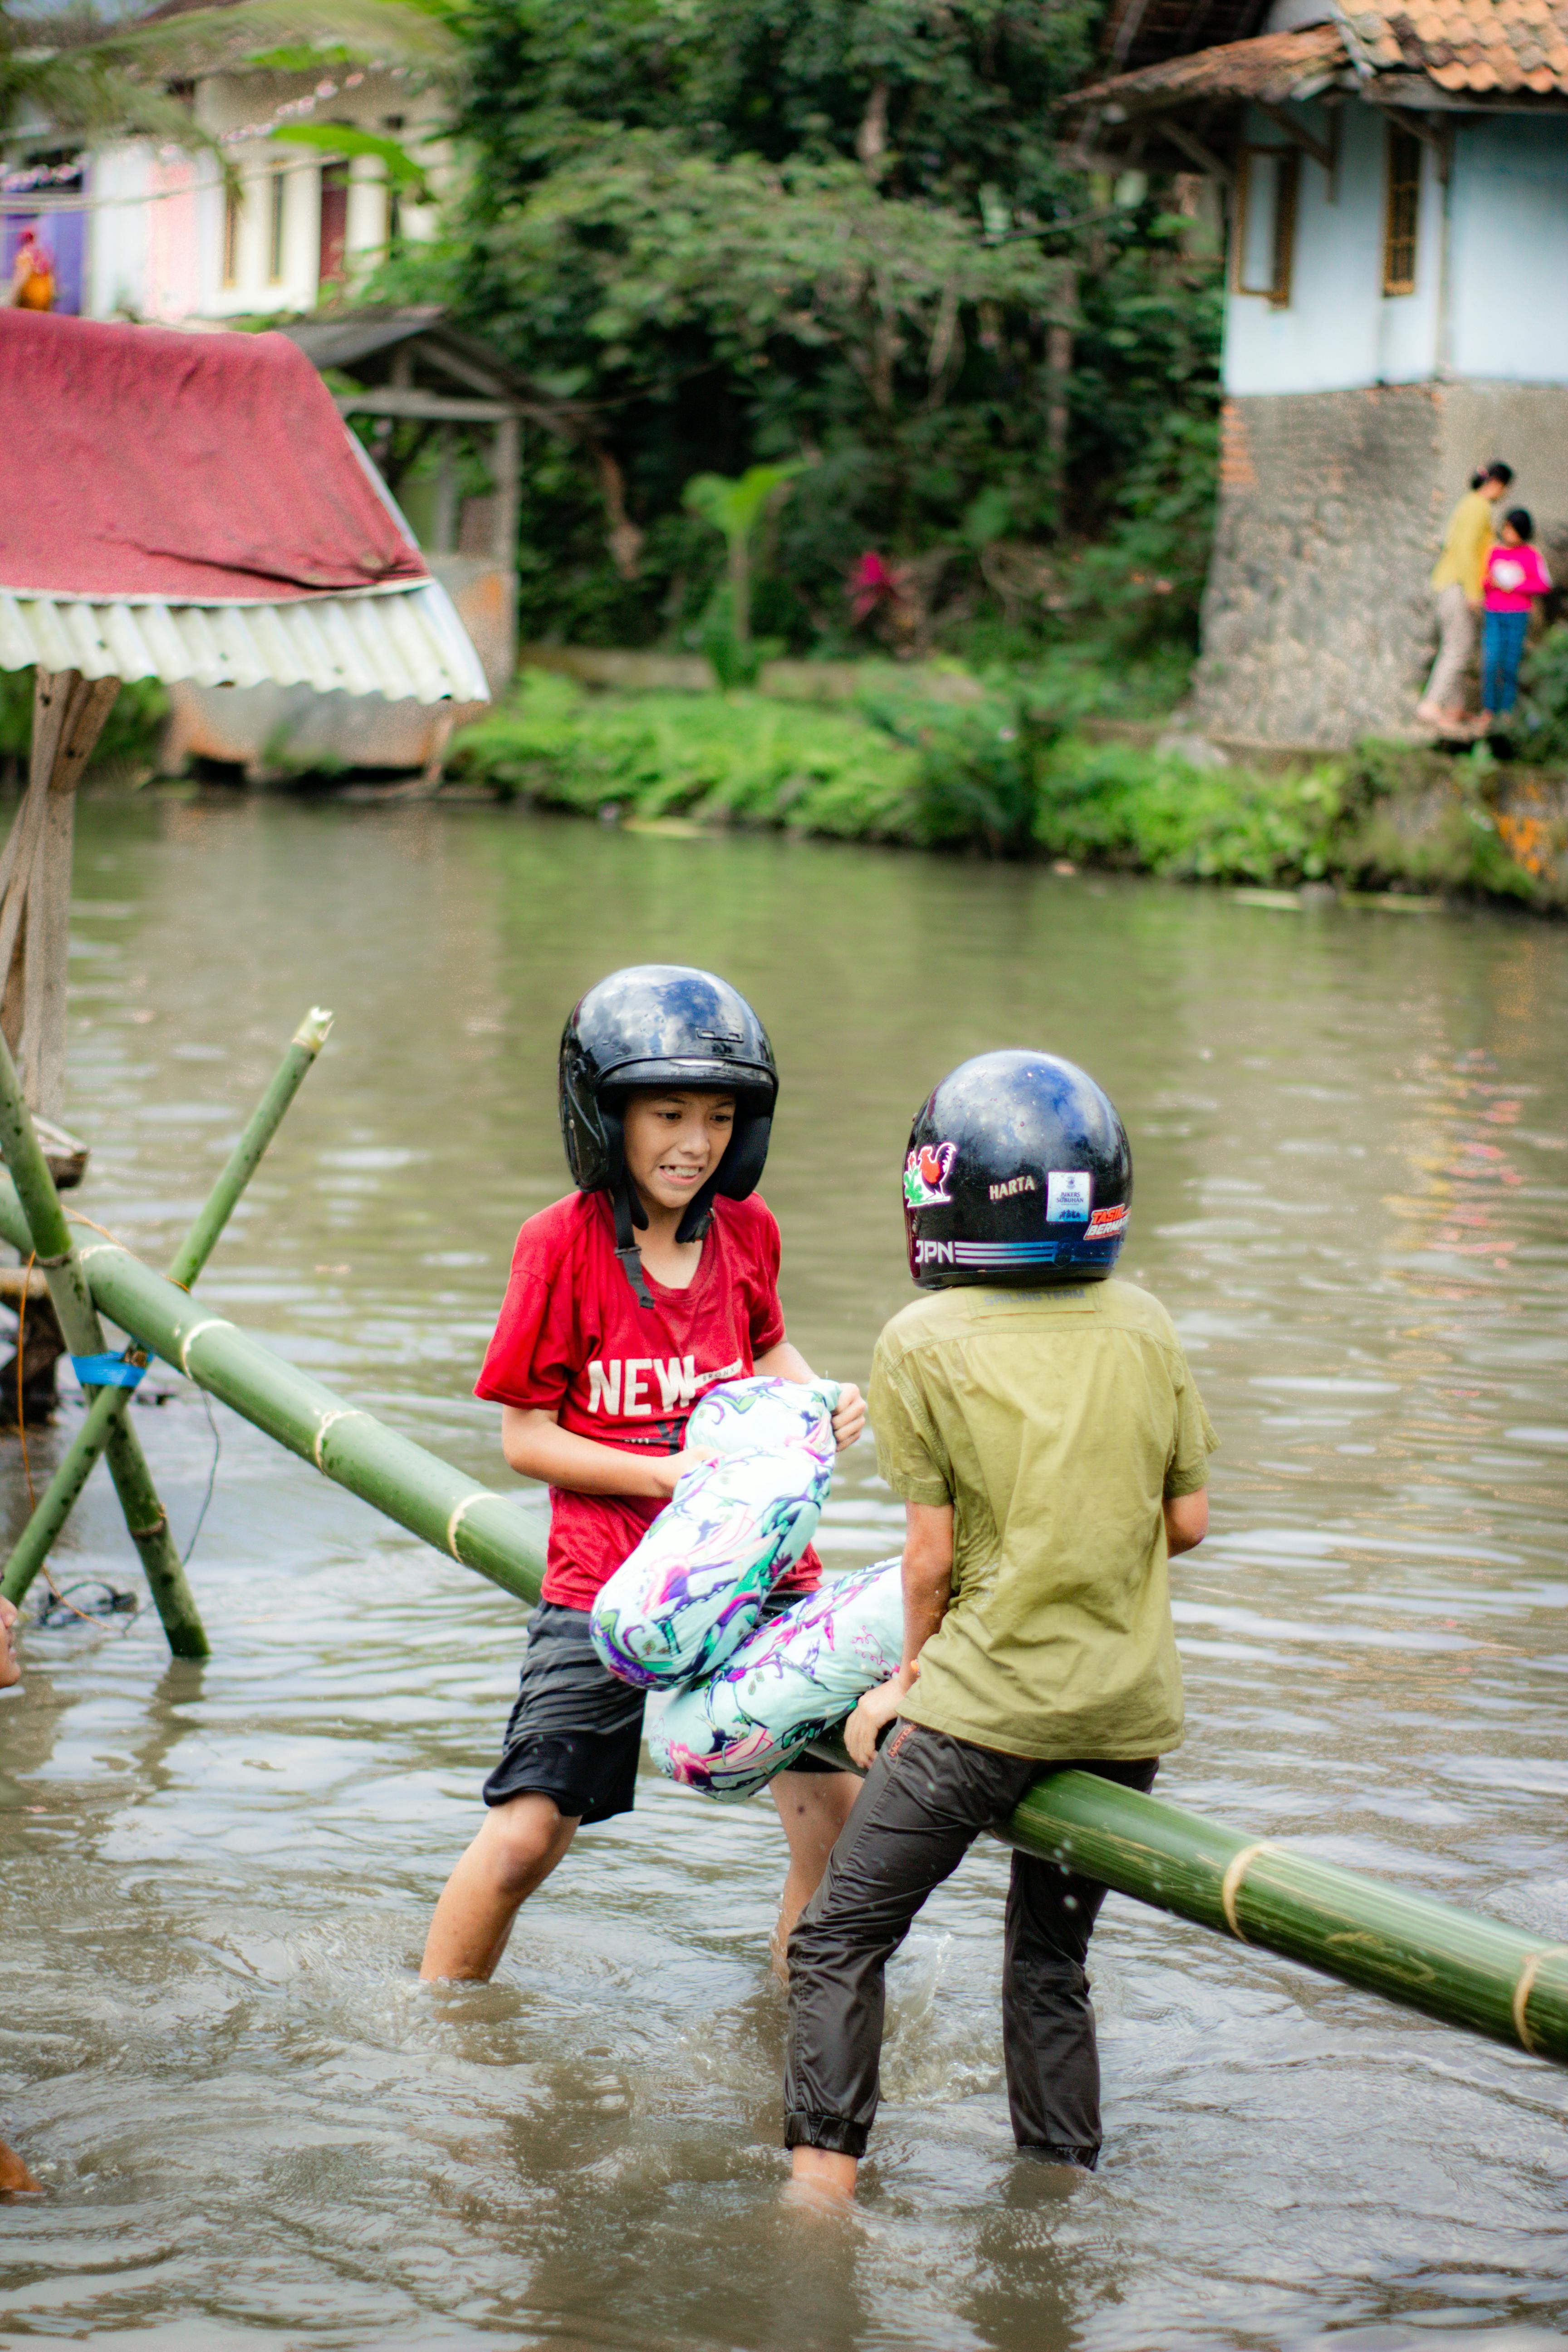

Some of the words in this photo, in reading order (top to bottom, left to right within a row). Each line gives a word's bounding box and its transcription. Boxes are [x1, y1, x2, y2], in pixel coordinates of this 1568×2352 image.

[989, 1176, 1035, 1200] HARTA
[1093, 1207, 1127, 1225] TASIK
[915, 1240, 953, 1263] JPN
[984, 1291, 1041, 1306] SAILING
[1046, 1289, 1086, 1301] TEAM
[703, 1367, 735, 1382] BRONX
[588, 1355, 695, 1416] NEW
